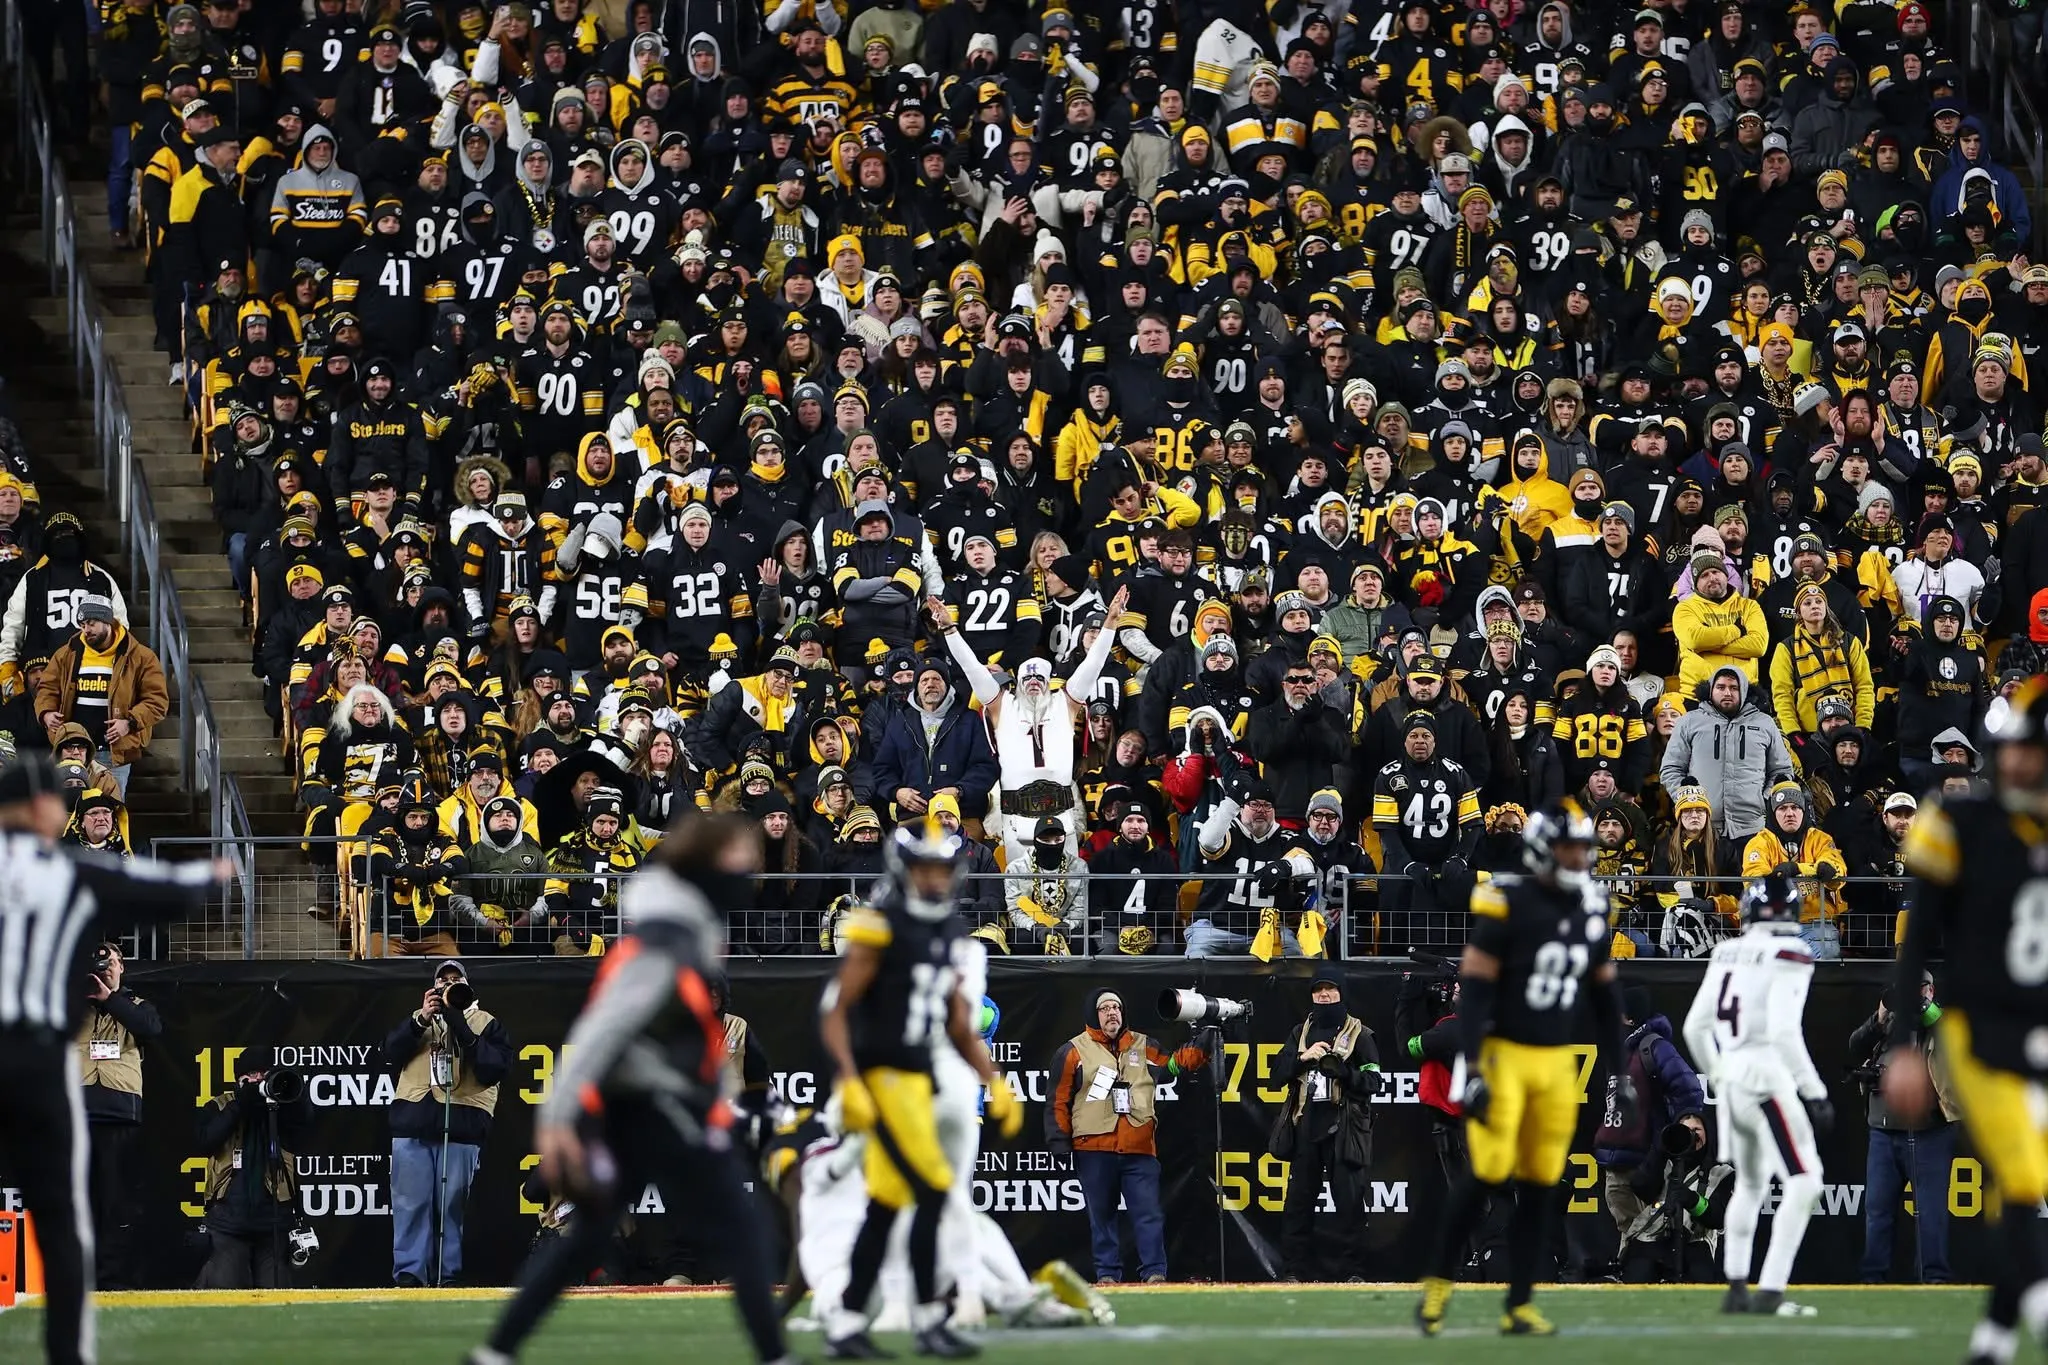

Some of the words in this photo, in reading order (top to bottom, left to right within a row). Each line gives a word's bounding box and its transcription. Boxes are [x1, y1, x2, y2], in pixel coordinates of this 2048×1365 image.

[321, 39, 344, 72] 9
[1219, 29, 1238, 45] 32
[1405, 58, 1435, 99] 4
[983, 123, 1003, 160] 9
[1389, 229, 1430, 270] 97
[1528, 231, 1571, 272] 39
[378, 260, 412, 297] 41
[465, 256, 507, 300] 97
[537, 373, 578, 417] 90
[1213, 357, 1247, 394] 90
[1646, 483, 1669, 523] 7
[576, 573, 624, 622] 58
[672, 572, 722, 620] 32
[965, 587, 1012, 632] 22
[1030, 724, 1047, 768] 1
[1573, 713, 1623, 760] 88
[1403, 792, 1453, 840] 43
[1122, 878, 1148, 915] 4
[1716, 971, 1741, 1038] 4
[272, 1046, 372, 1067] JOHNNY
[1221, 1043, 1292, 1104] 75
[1216, 1150, 1291, 1213] 59
